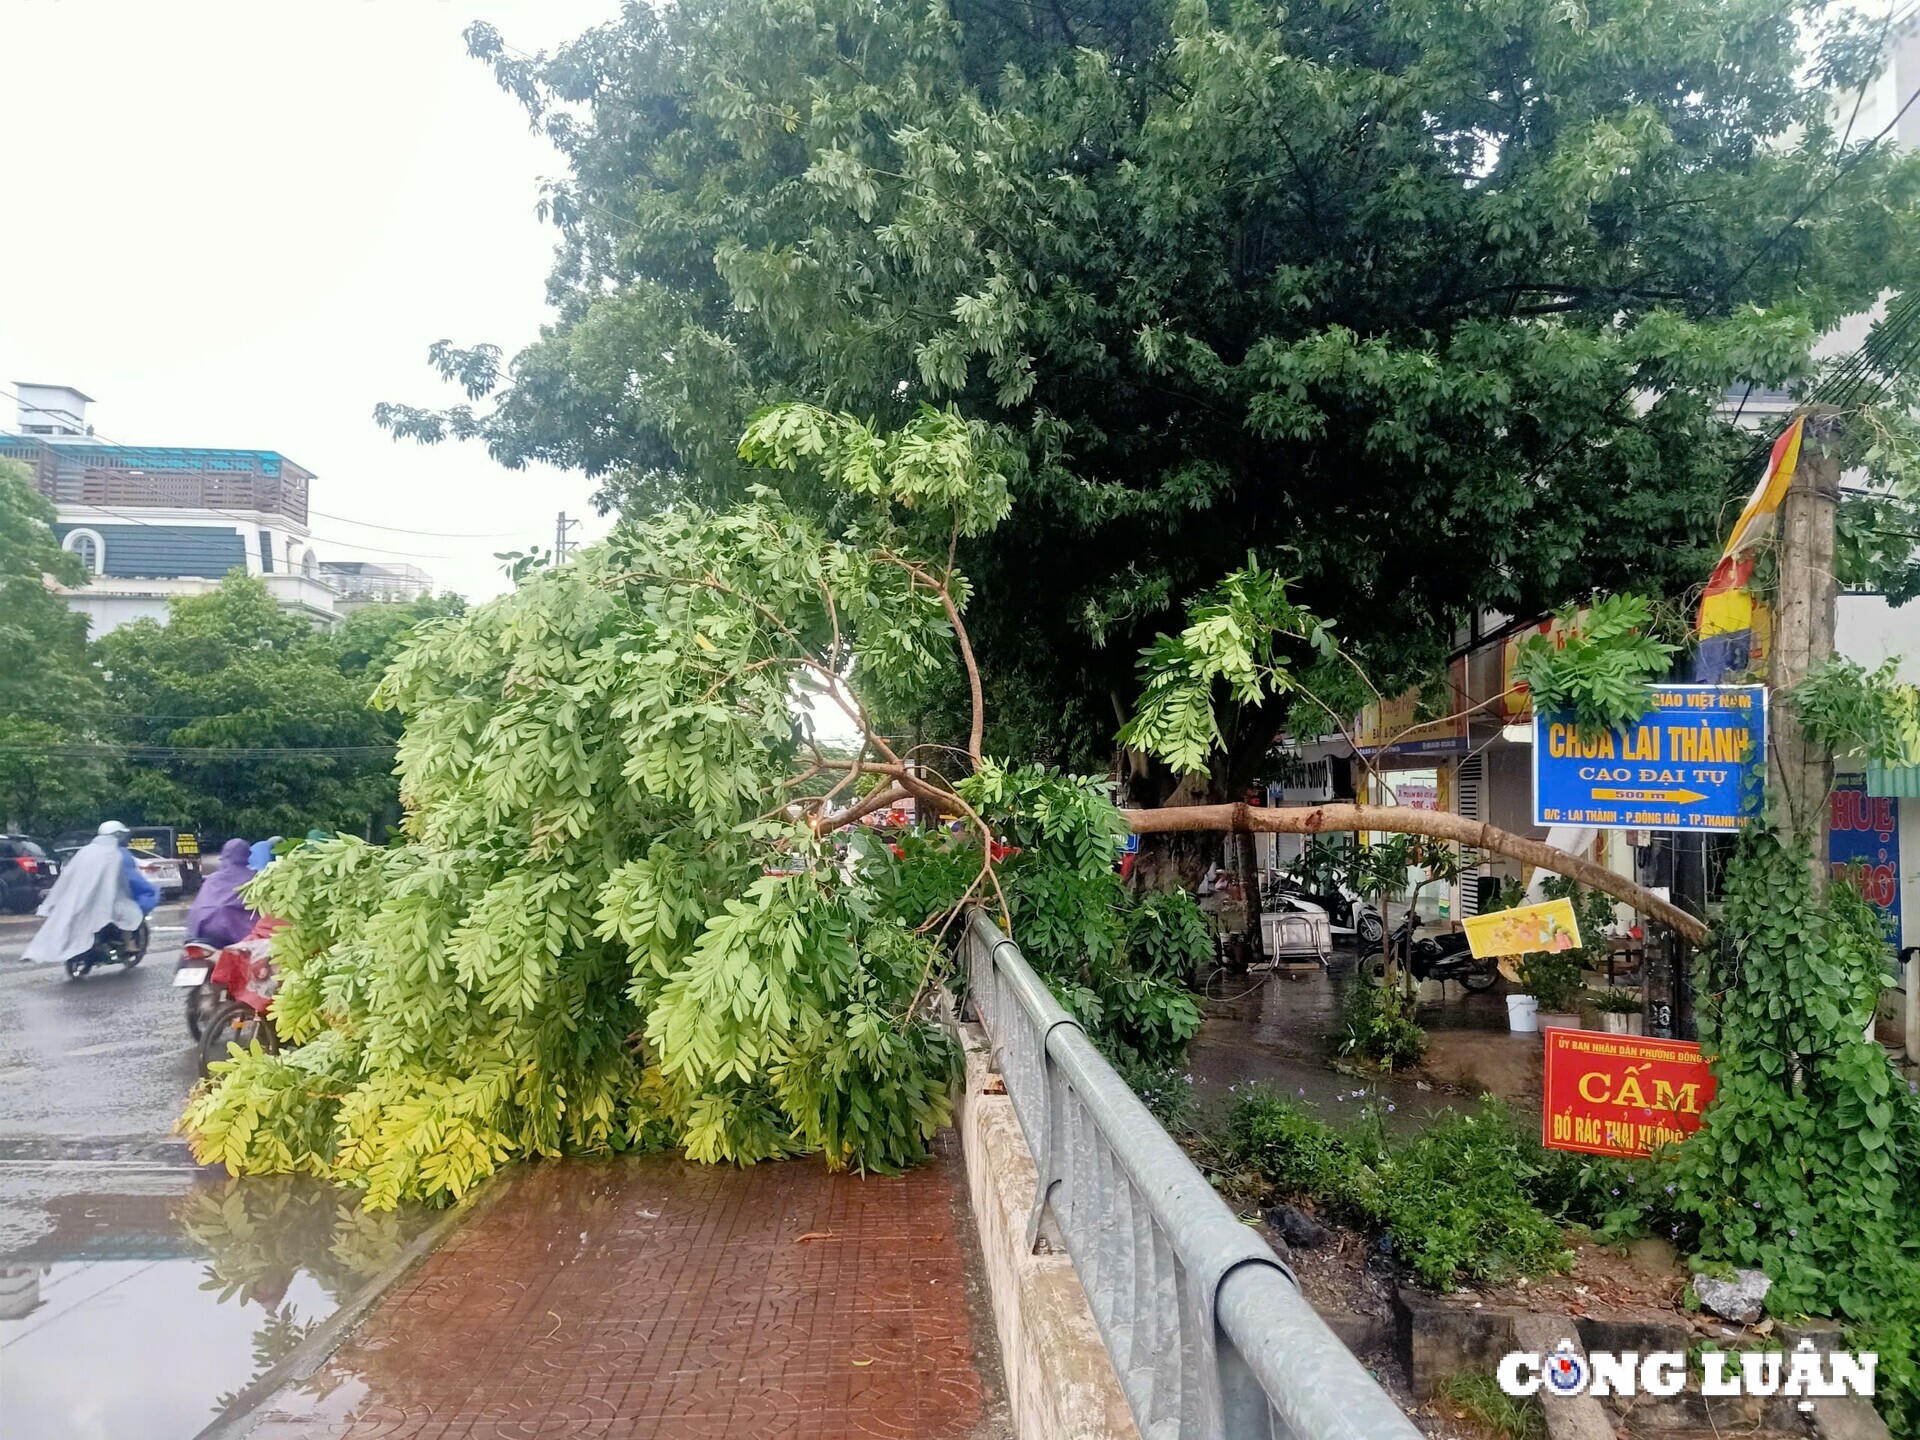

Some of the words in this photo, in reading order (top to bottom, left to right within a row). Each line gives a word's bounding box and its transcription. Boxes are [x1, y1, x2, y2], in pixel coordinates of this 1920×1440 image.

[1687, 692, 1716, 710] VIỆT
[1719, 694, 1752, 708] NAM
[1622, 726, 1661, 762] LAI
[1668, 719, 1750, 763] THÀNH
[1579, 767, 1632, 782] CAO
[1638, 769, 1685, 786] ĐẠI
[1693, 770, 1728, 787] TỰ
[1615, 791, 1645, 800] 500
[1651, 792, 1666, 800] m
[1568, 810, 1583, 822] LAI
[1585, 808, 1617, 823] THÀNH
[1626, 810, 1661, 825] P.ĐÔNG
[1689, 814, 1735, 828] TP.THANH
[1829, 790, 1896, 842] HUỆ
[1558, 1036, 1570, 1049] ỦY
[1572, 1040, 1590, 1051] BAN
[1592, 1043, 1617, 1055] NHÂN
[1619, 1044, 1638, 1056] DÂN
[1639, 1046, 1676, 1060] PHƯỜNG
[1678, 1050, 1703, 1063] ĐÔNG
[1578, 1062, 1701, 1115] CẤM
[1554, 1105, 1572, 1141] ĐỔ
[1575, 1112, 1601, 1144] RÁC
[1605, 1111, 1634, 1149] THẢI
